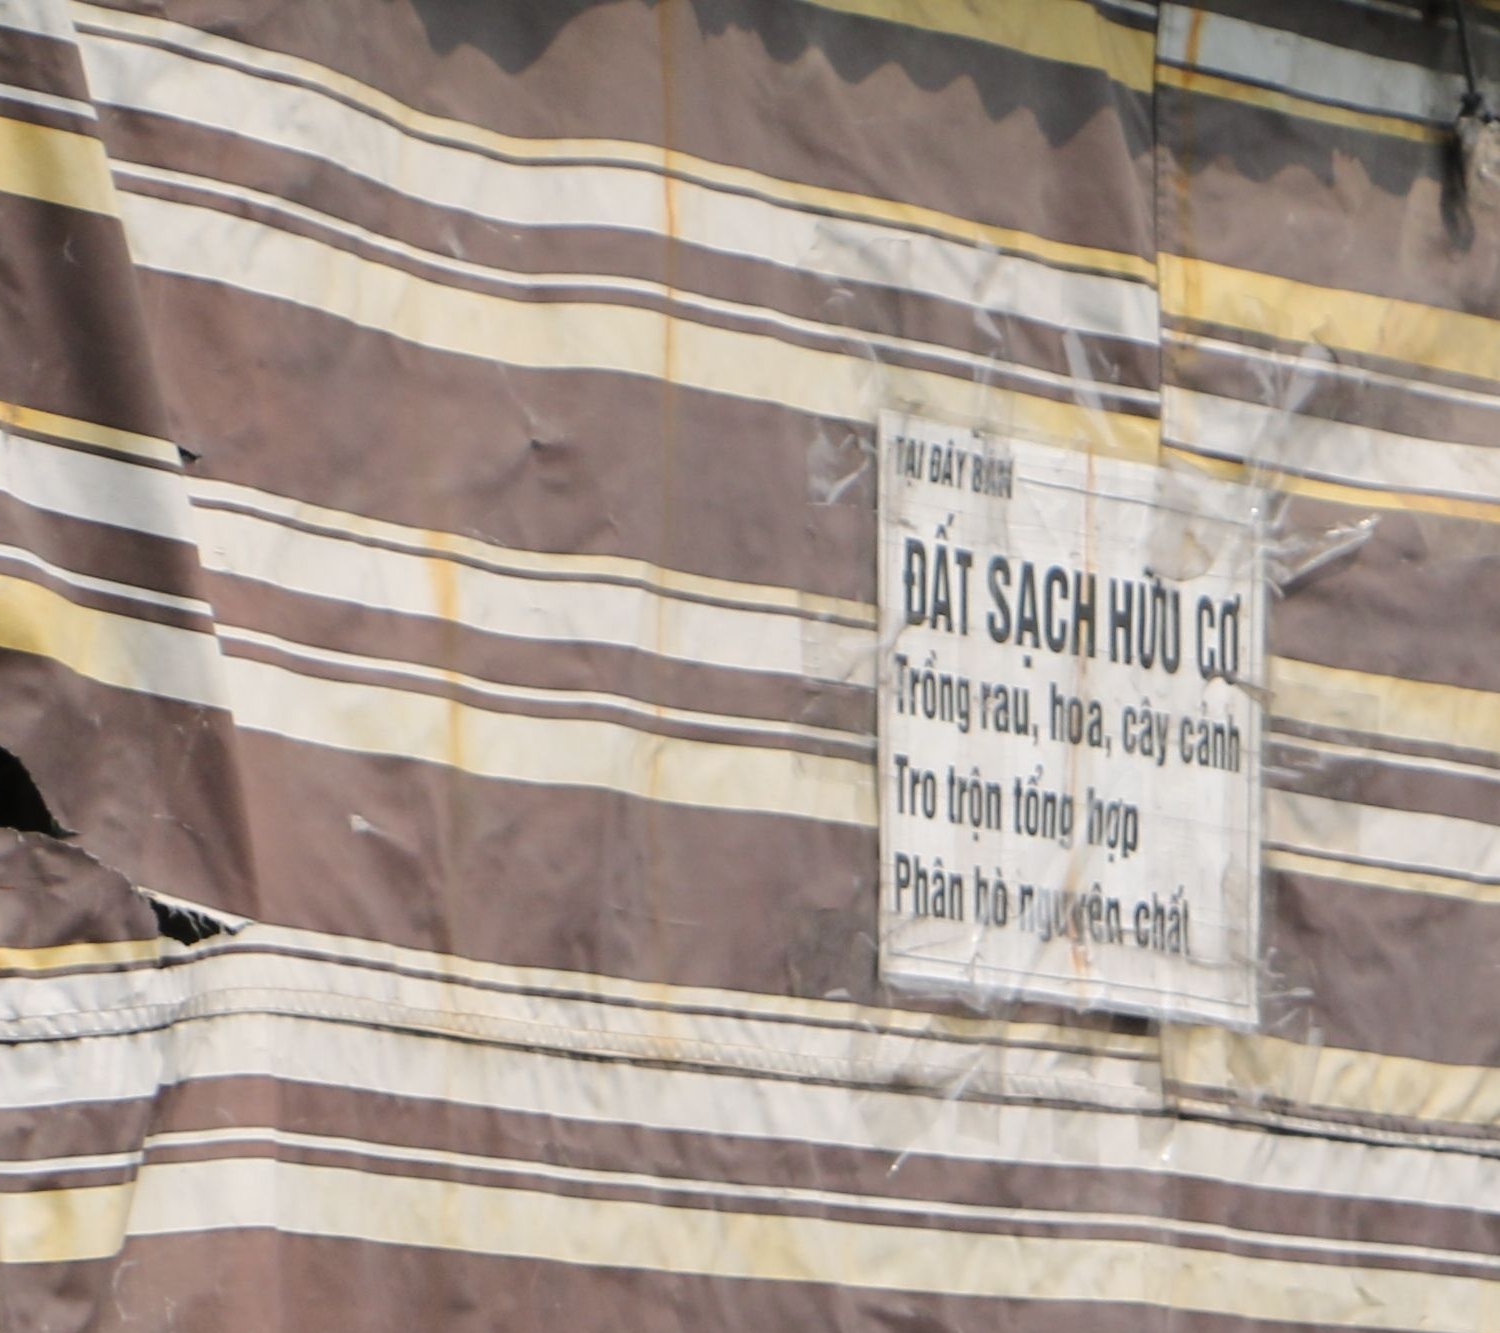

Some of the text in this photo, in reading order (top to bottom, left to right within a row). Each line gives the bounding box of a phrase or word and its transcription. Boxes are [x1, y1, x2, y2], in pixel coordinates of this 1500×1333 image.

[895, 436, 927, 487] TẠI
[928, 438, 965, 490] ĐÂY
[903, 512, 974, 636] ĐẤT
[986, 554, 1097, 669] SẠCH
[1195, 593, 1242, 684] CƠ
[894, 650, 1242, 773] Trồng rau, hoa, cây cảnh
[894, 753, 1140, 864] Tro trộn tổng hợp
[894, 851, 964, 923] Phân
[1133, 884, 1192, 955] chất
